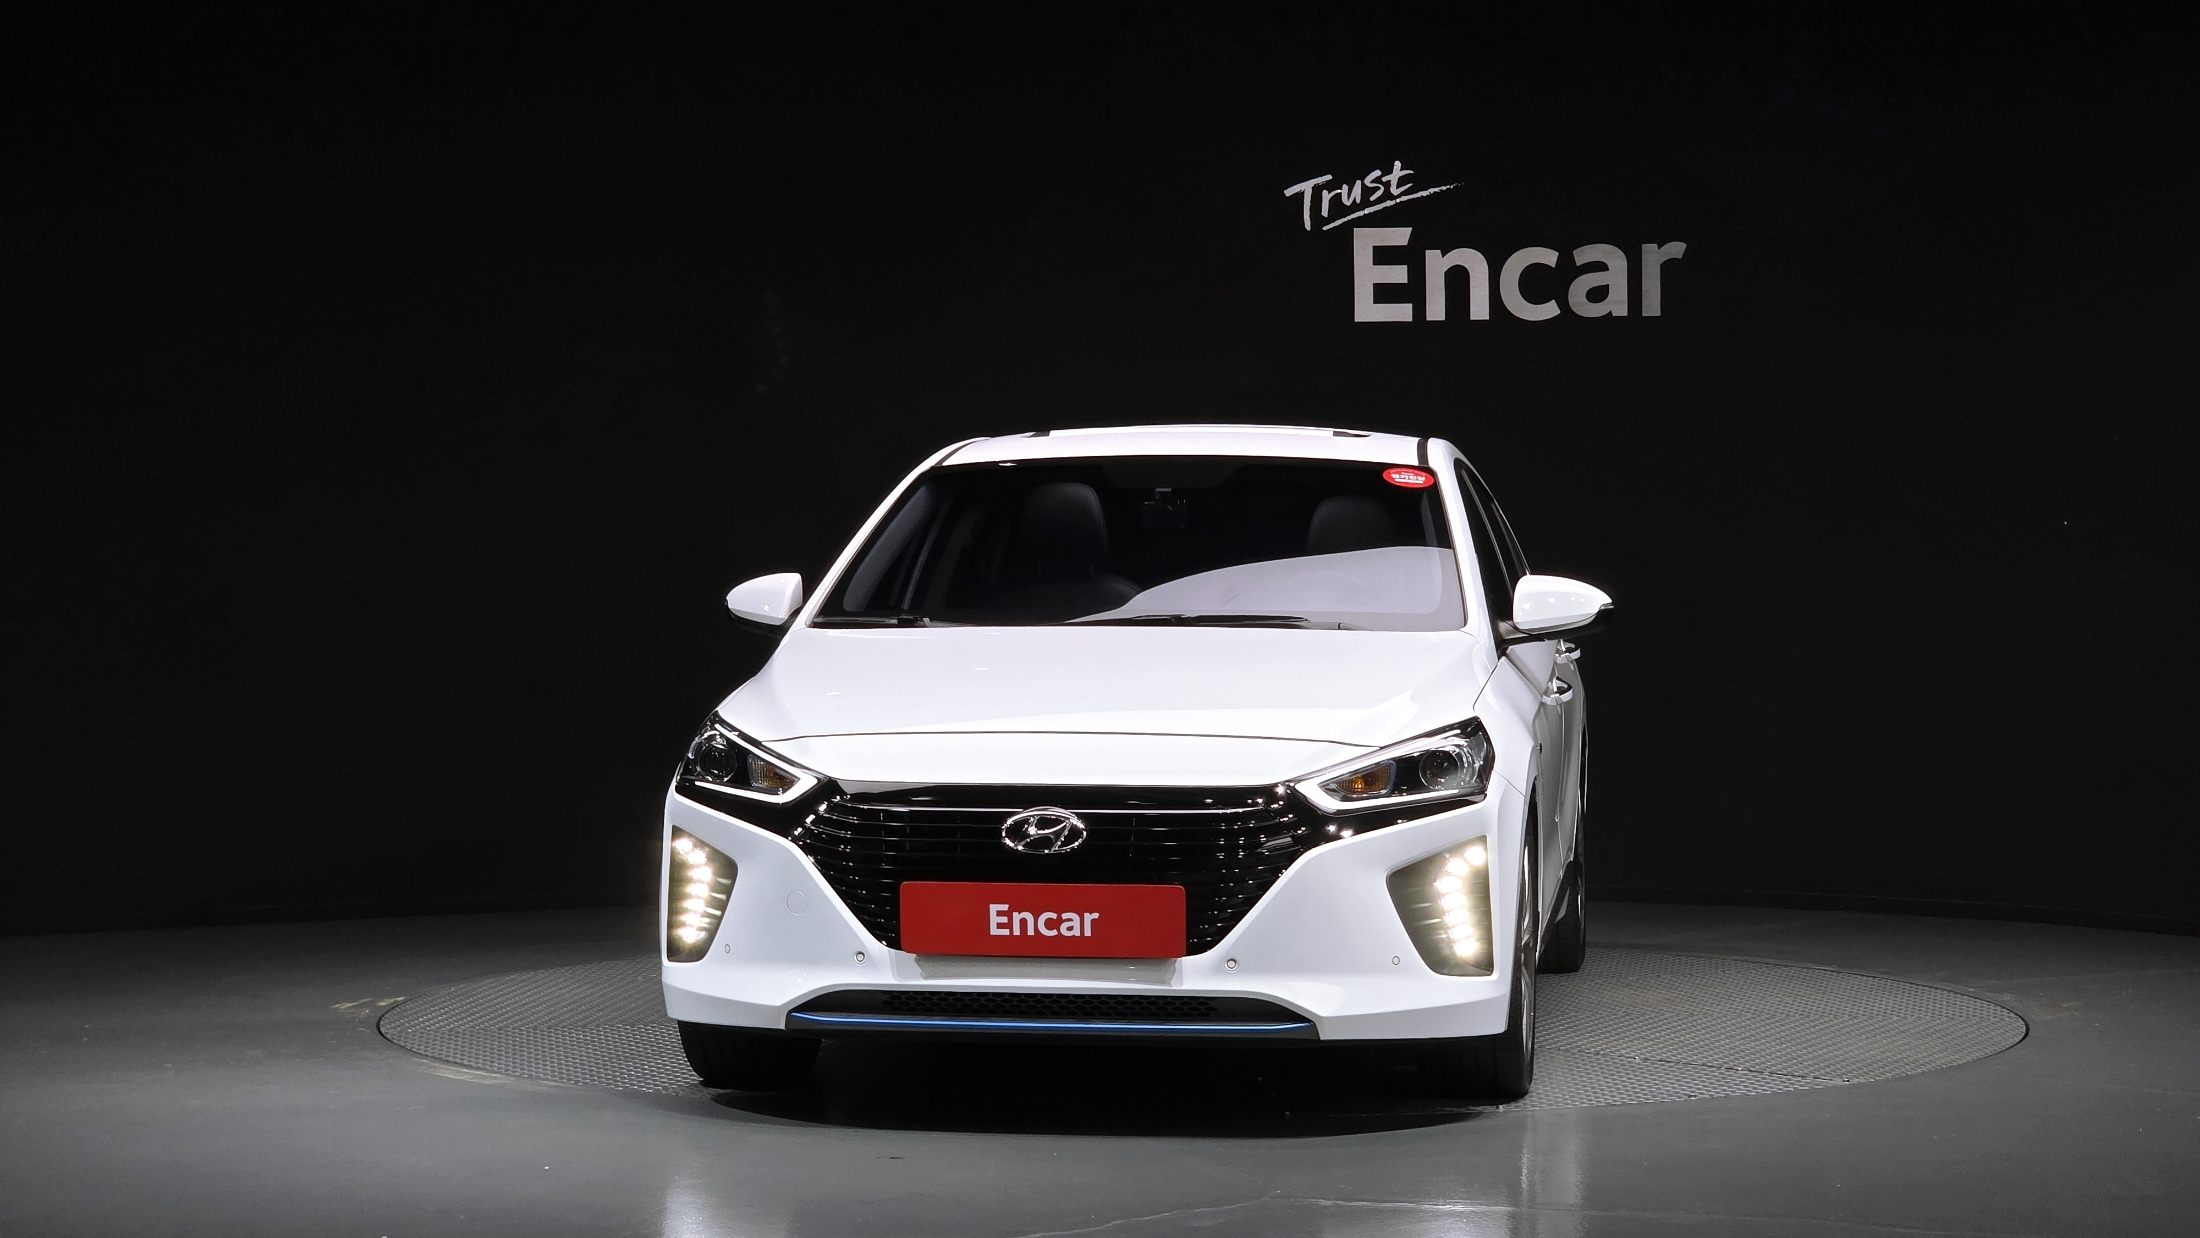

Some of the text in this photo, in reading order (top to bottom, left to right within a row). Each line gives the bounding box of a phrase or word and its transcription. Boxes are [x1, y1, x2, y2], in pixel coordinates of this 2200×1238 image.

[1283, 160, 1415, 232] Trust
[1353, 226, 1688, 323] Encar
[988, 903, 1100, 937] Encar
